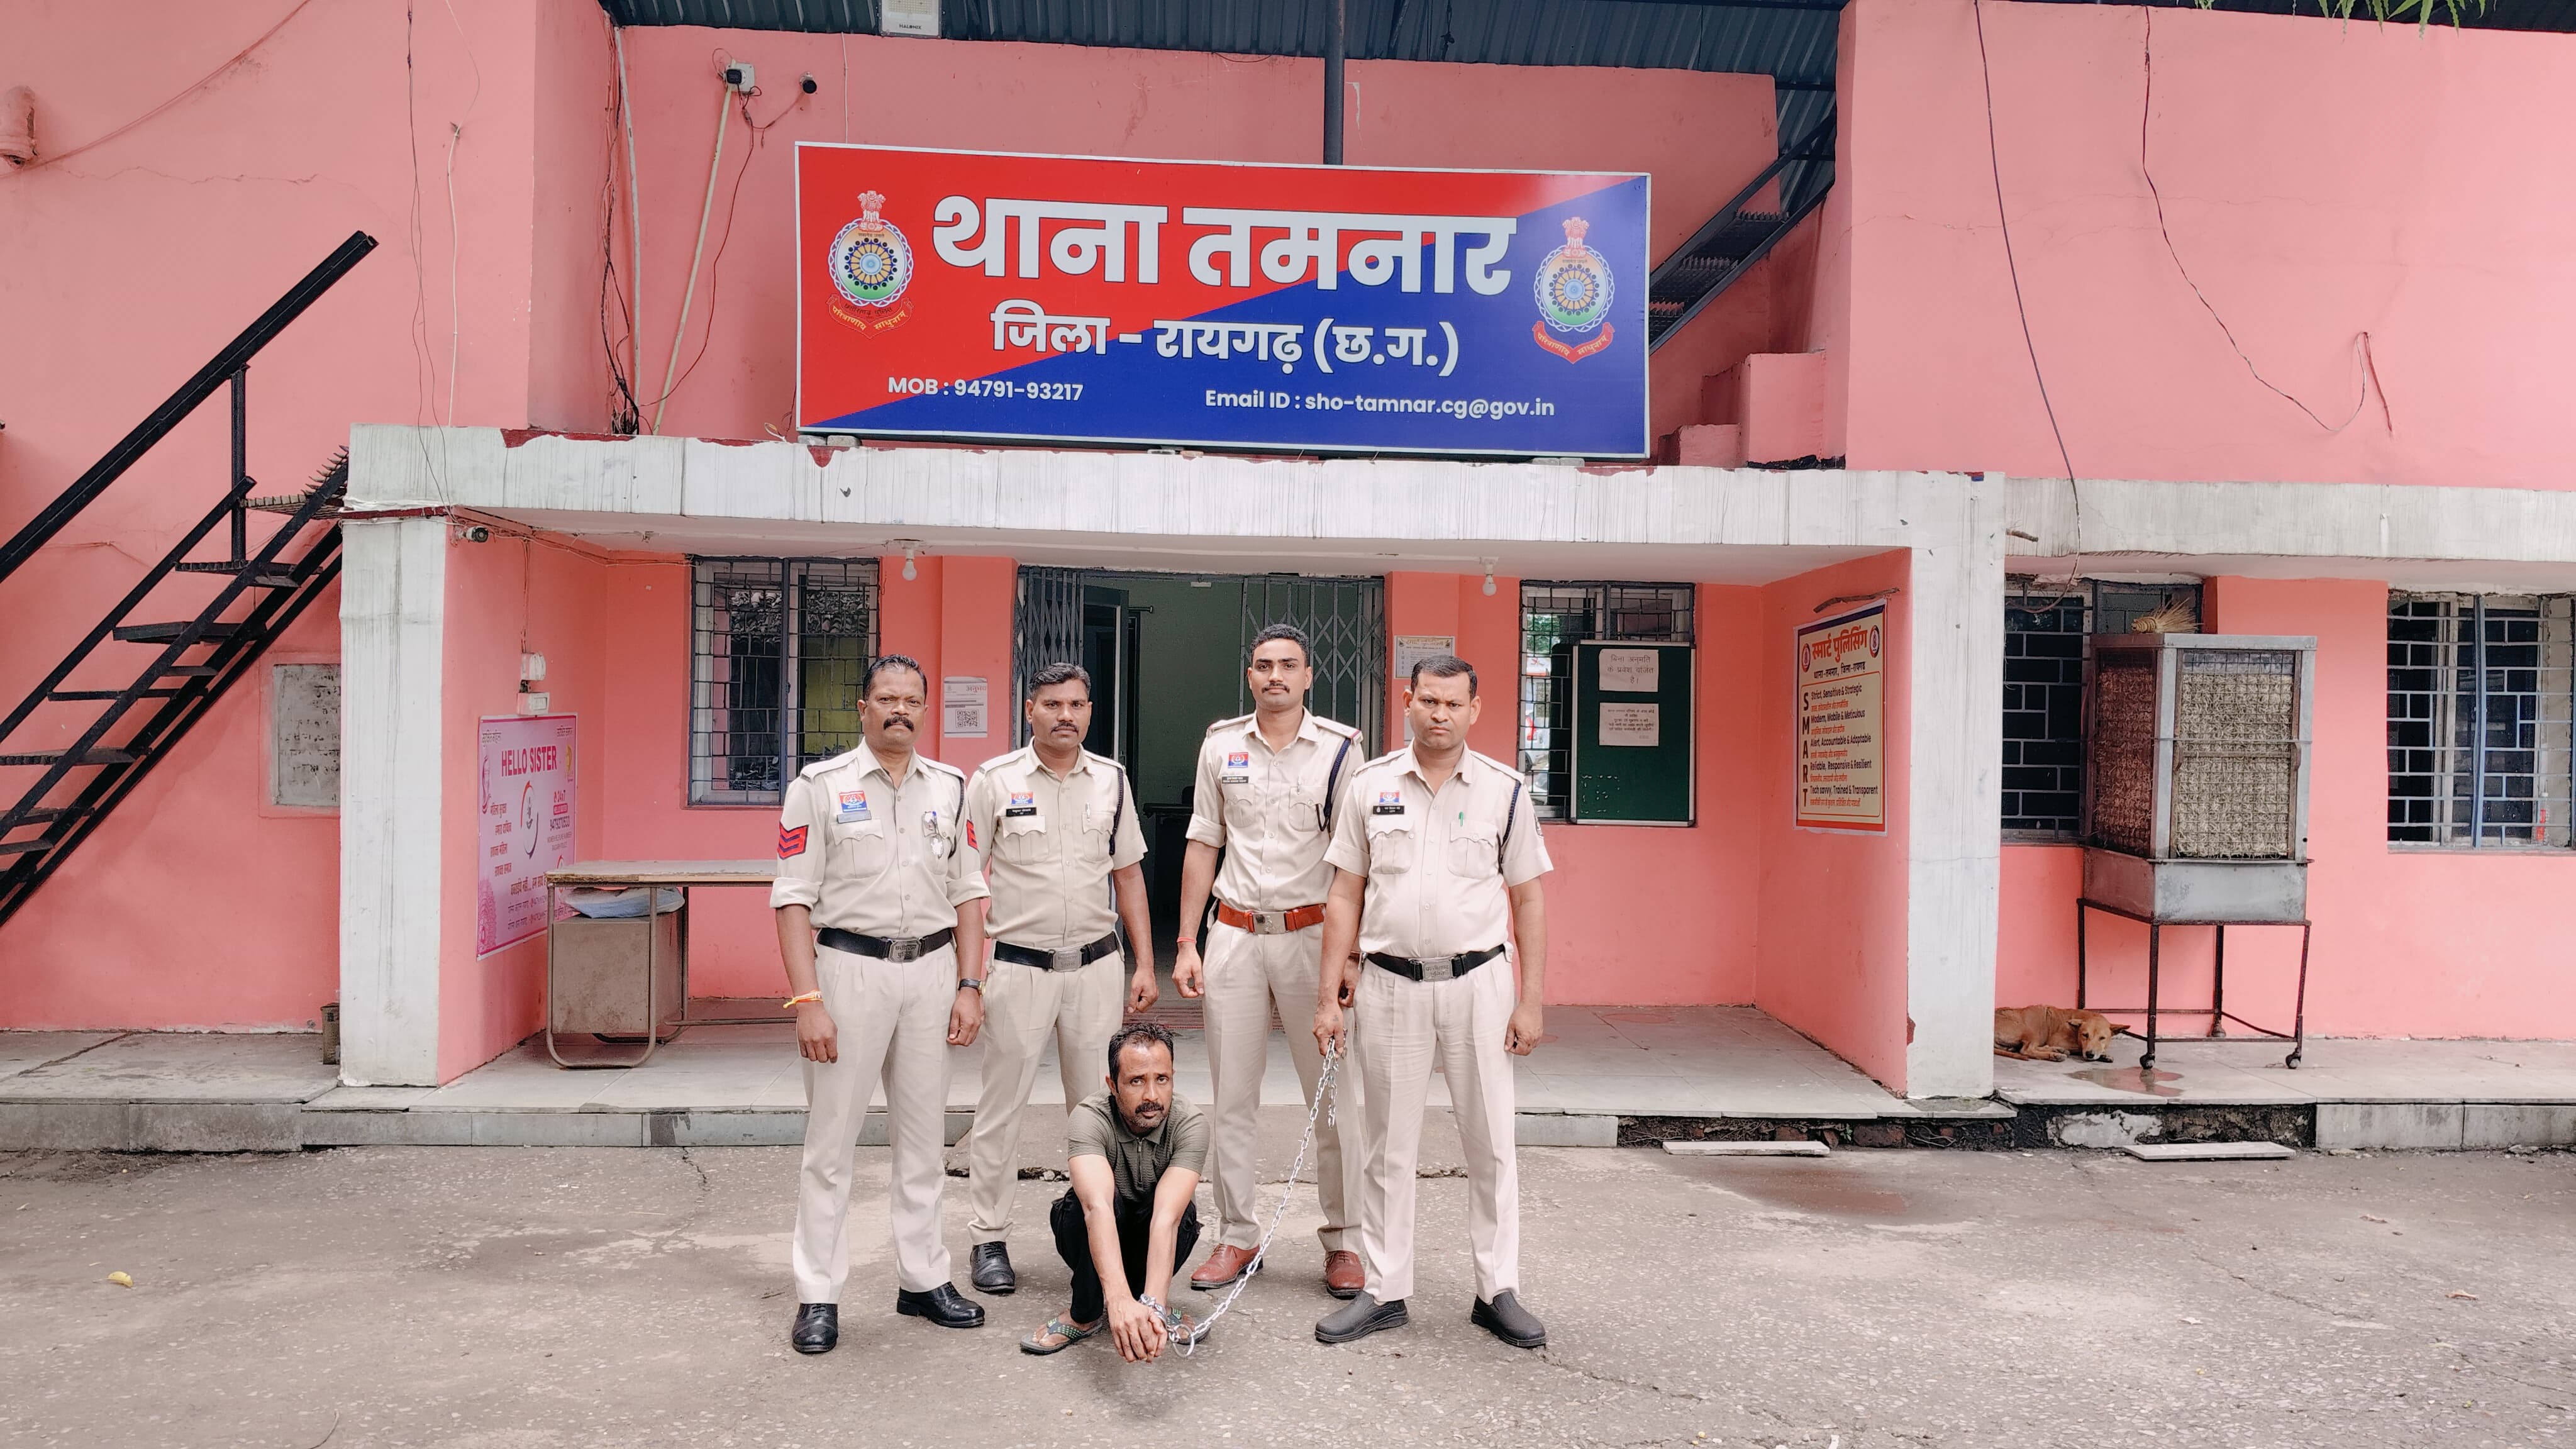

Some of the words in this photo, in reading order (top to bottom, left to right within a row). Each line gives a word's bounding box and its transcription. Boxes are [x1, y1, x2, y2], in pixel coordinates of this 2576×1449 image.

[932, 195, 1169, 284] थाना
[1182, 206, 1518, 296] तमनार
[989, 299, 1111, 355] जिला
[1153, 319, 1304, 375] रायगढ़
[1313, 318, 1459, 377] (छ.ग.)
[887, 377, 939, 395] MOB
[953, 379, 1084, 401] 94791-93217
[1206, 389, 1264, 408] Email
[1270, 392, 1290, 409] ID
[1305, 392, 1555, 421] sho-tamnar.cg@gov.in
[1812, 633, 1832, 660] स्मार्ट
[1833, 625, 1868, 663] पुलिसिंग
[1804, 692, 1809, 711] S
[1802, 716, 1810, 735] M
[501, 748, 528, 777] HELLO
[530, 745, 557, 773] SISTER
[1802, 740, 1809, 759] A
[1803, 764, 1808, 783] R
[1803, 788, 1808, 807] T
